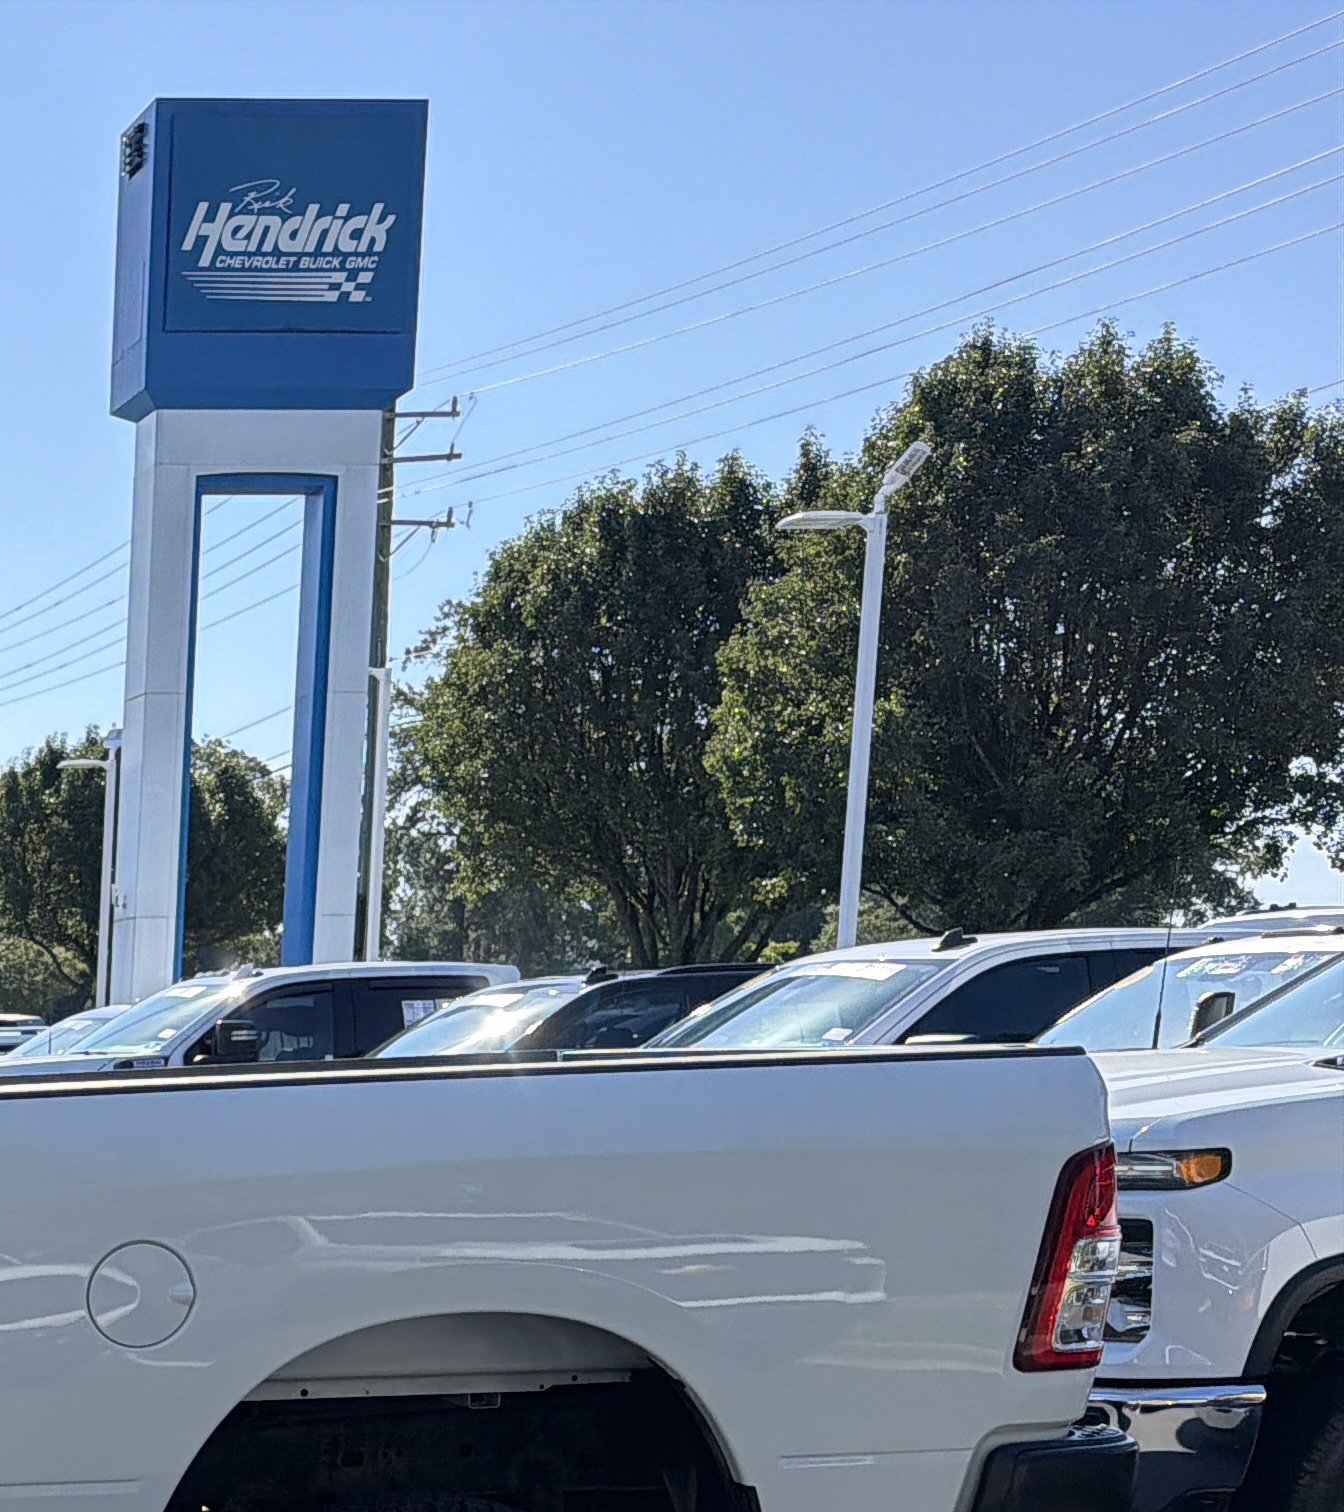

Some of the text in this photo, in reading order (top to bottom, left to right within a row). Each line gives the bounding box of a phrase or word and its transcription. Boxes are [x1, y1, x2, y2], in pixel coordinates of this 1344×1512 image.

[181, 201, 397, 268] Hendrick
[215, 255, 379, 269] CHEVROLET BUICK GMC
